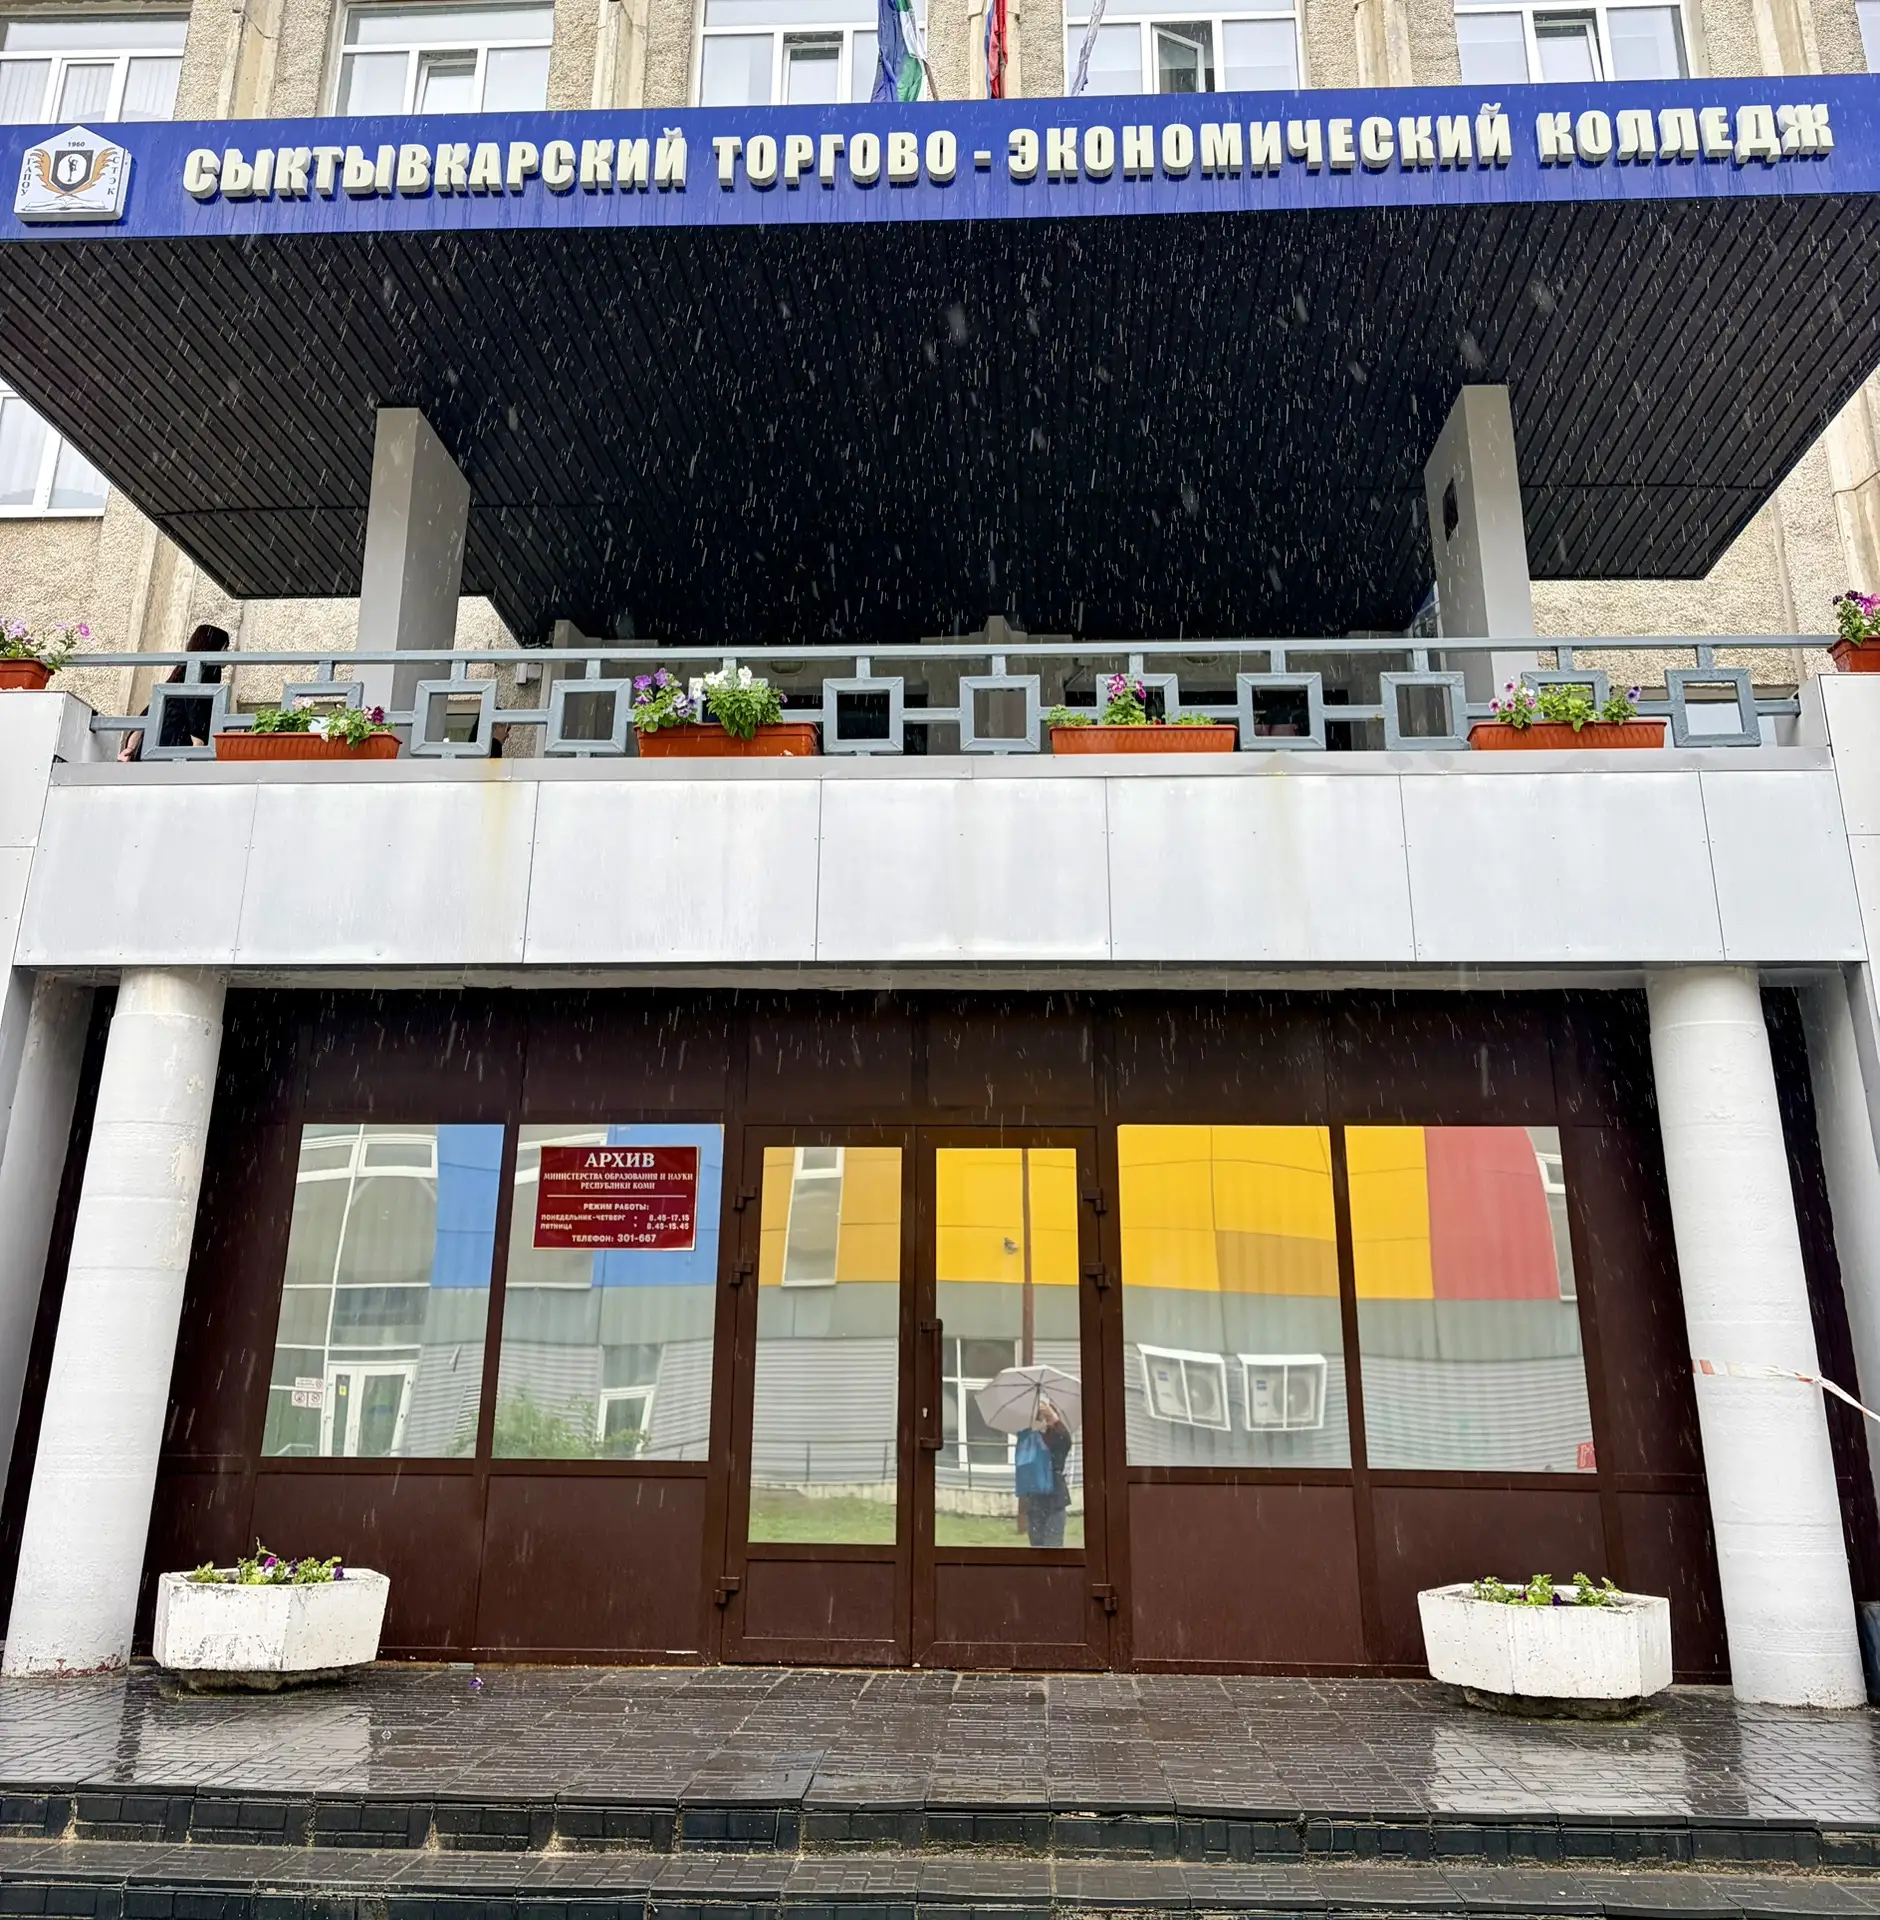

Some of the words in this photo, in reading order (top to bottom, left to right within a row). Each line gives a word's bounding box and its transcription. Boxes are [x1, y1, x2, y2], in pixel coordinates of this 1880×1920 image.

[182, 127, 688, 200] СЫКТЫВКАРСКИЙ
[712, 130, 958, 187] ТОРГОВО
[1007, 102, 1513, 180] ЭКОНОМИЧЕСКИЙ
[1535, 103, 1835, 168] КОЛЛЕДЖ
[20, 158, 35, 196] ГАПОУ
[107, 156, 121, 195] СТЭК
[584, 1152, 655, 1168] АРХИВ
[544, 1172, 602, 1181] МИНИСТЕРСТВА
[604, 1173, 658, 1181] ОБРАЗОВАНИЯ
[668, 1173, 693, 1181] НАУКИ
[580, 1181, 631, 1190] РЕСПУБЛИКИ
[632, 1182, 655, 1190] КОМИ
[614, 1203, 650, 1211] РАБОТЫ:
[571, 1234, 614, 1243] ТЕЛЕФОН:
